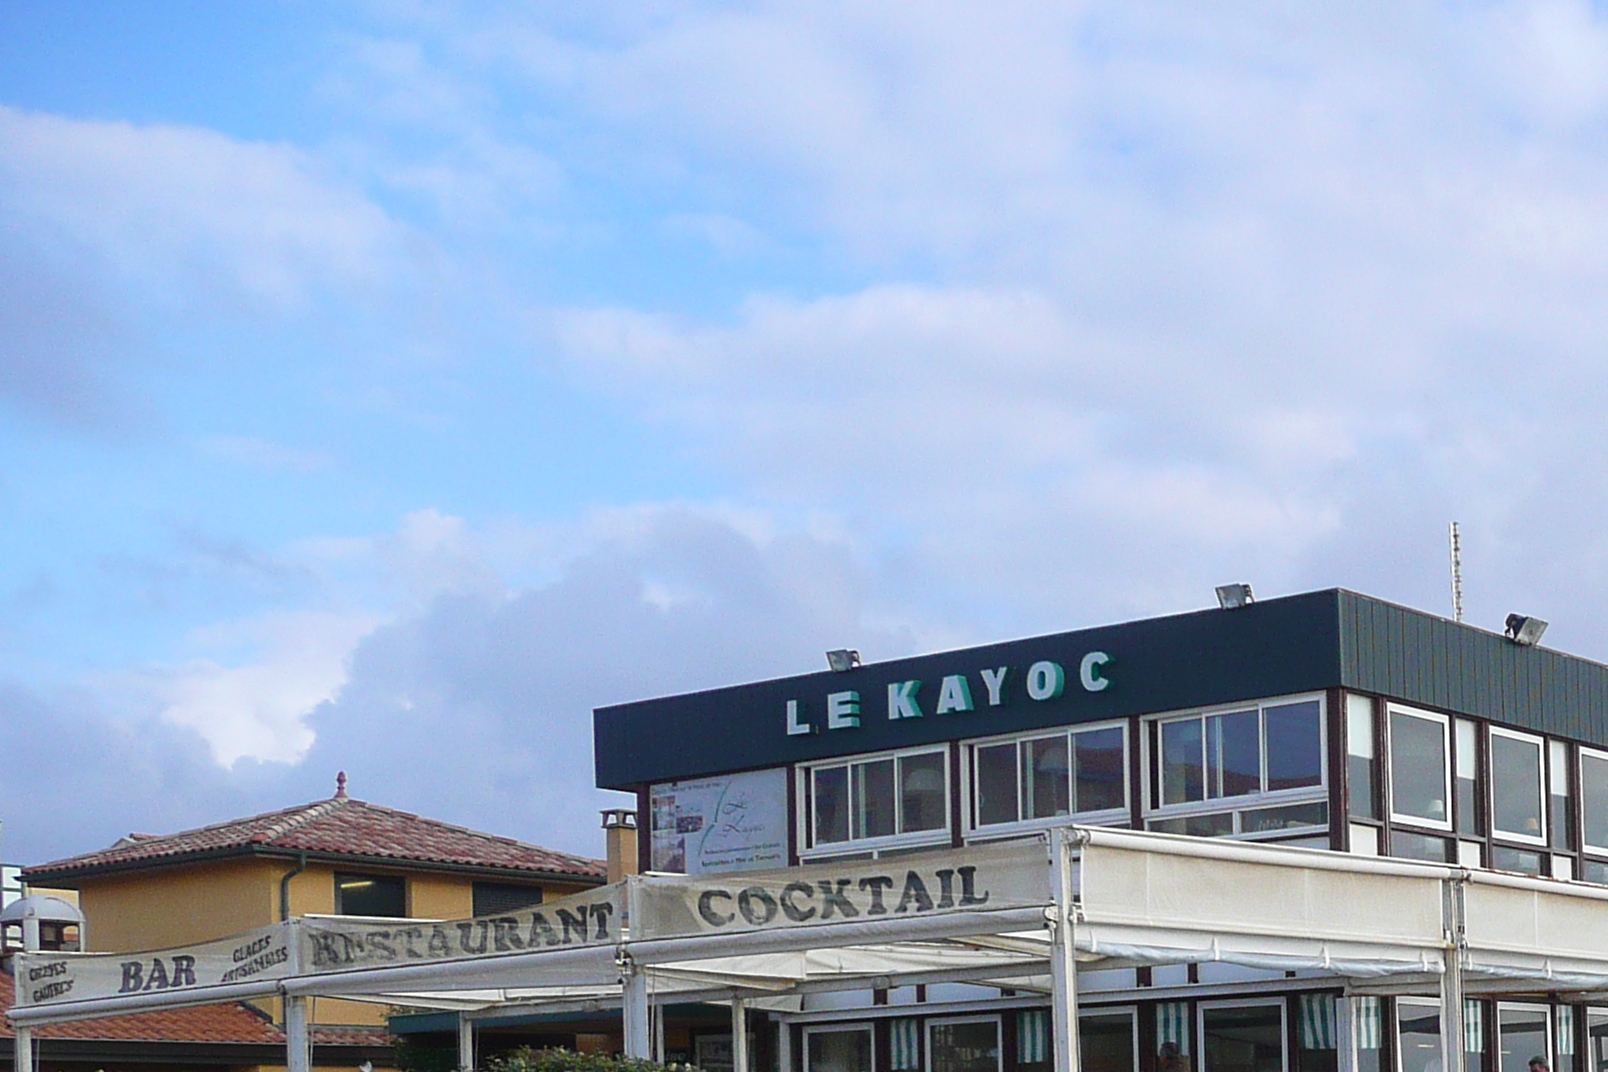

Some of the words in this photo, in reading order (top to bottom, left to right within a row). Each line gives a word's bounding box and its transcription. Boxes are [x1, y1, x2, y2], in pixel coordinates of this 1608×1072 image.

[787, 690, 860, 735] LE
[887, 651, 1114, 720] KAYOC
[697, 865, 990, 927] COCKTAIL
[233, 935, 271, 963] GLACES
[308, 901, 614, 967] RESTAURANT
[118, 954, 196, 994] BAR
